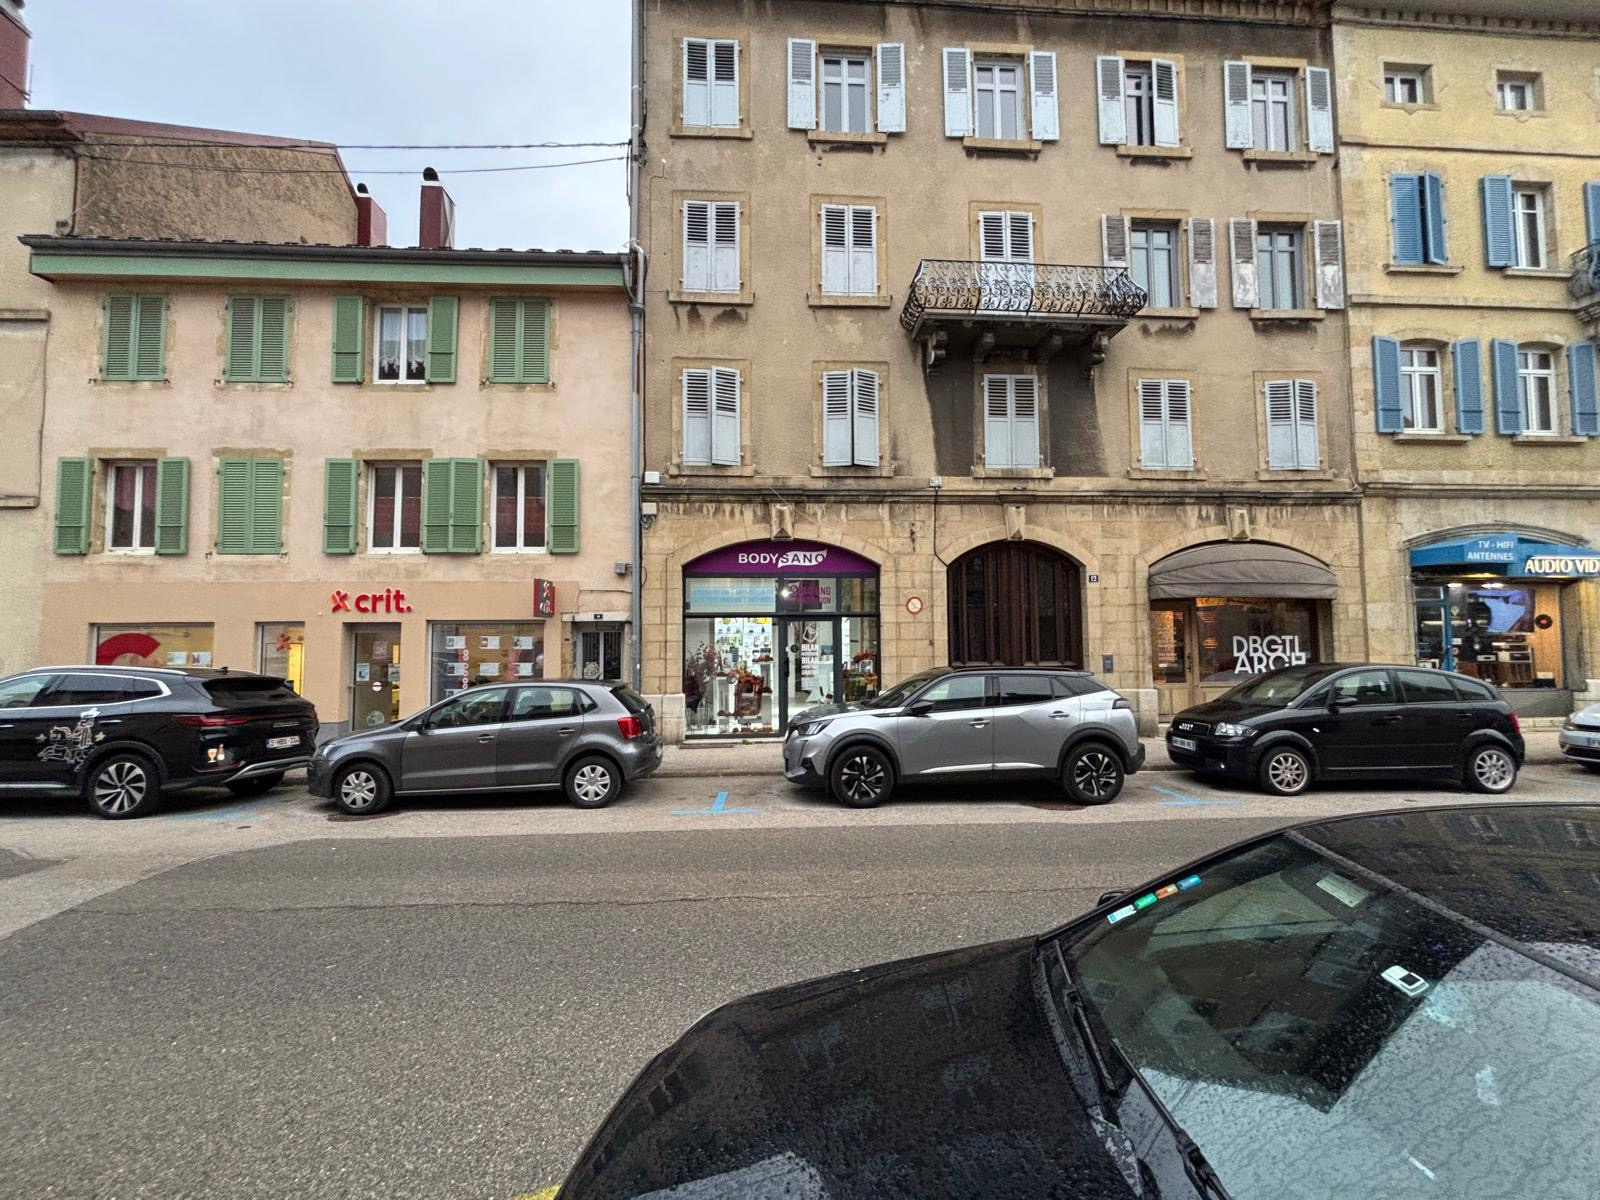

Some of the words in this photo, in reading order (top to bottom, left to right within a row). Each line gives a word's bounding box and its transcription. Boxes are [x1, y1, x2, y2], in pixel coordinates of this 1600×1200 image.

[1478, 540, 1490, 549] TV
[1496, 541, 1514, 549] HIFI
[1467, 552, 1514, 560] ANTENNES
[1524, 559, 1573, 573] AUDIO
[355, 588, 412, 613] crit.
[1232, 634, 1306, 657] DBGTL
